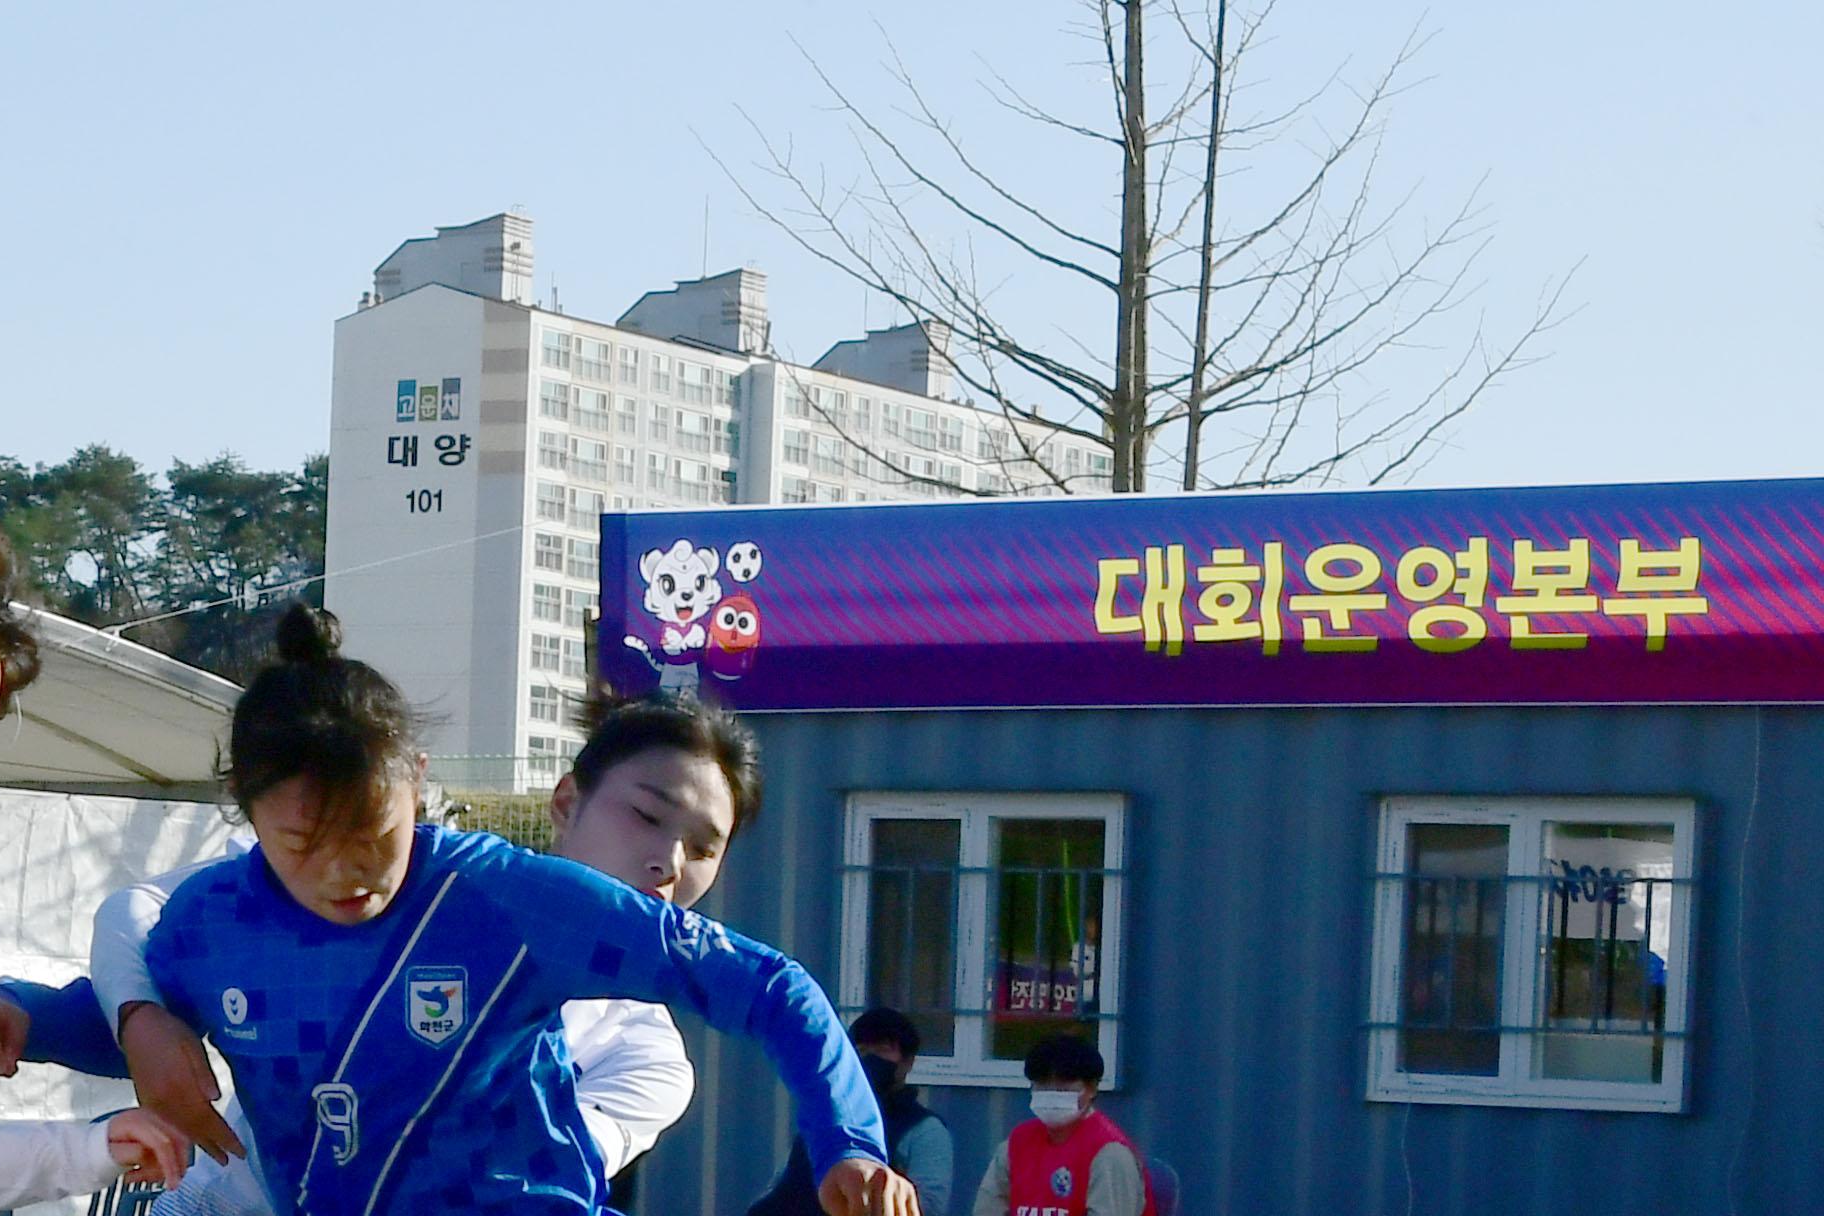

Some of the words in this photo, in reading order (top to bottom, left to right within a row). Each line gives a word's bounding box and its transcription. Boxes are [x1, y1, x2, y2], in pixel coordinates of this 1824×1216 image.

[406, 489, 443, 513] 101
[1095, 536, 1707, 655] 대회운영본부
[312, 1083, 360, 1166] 9
